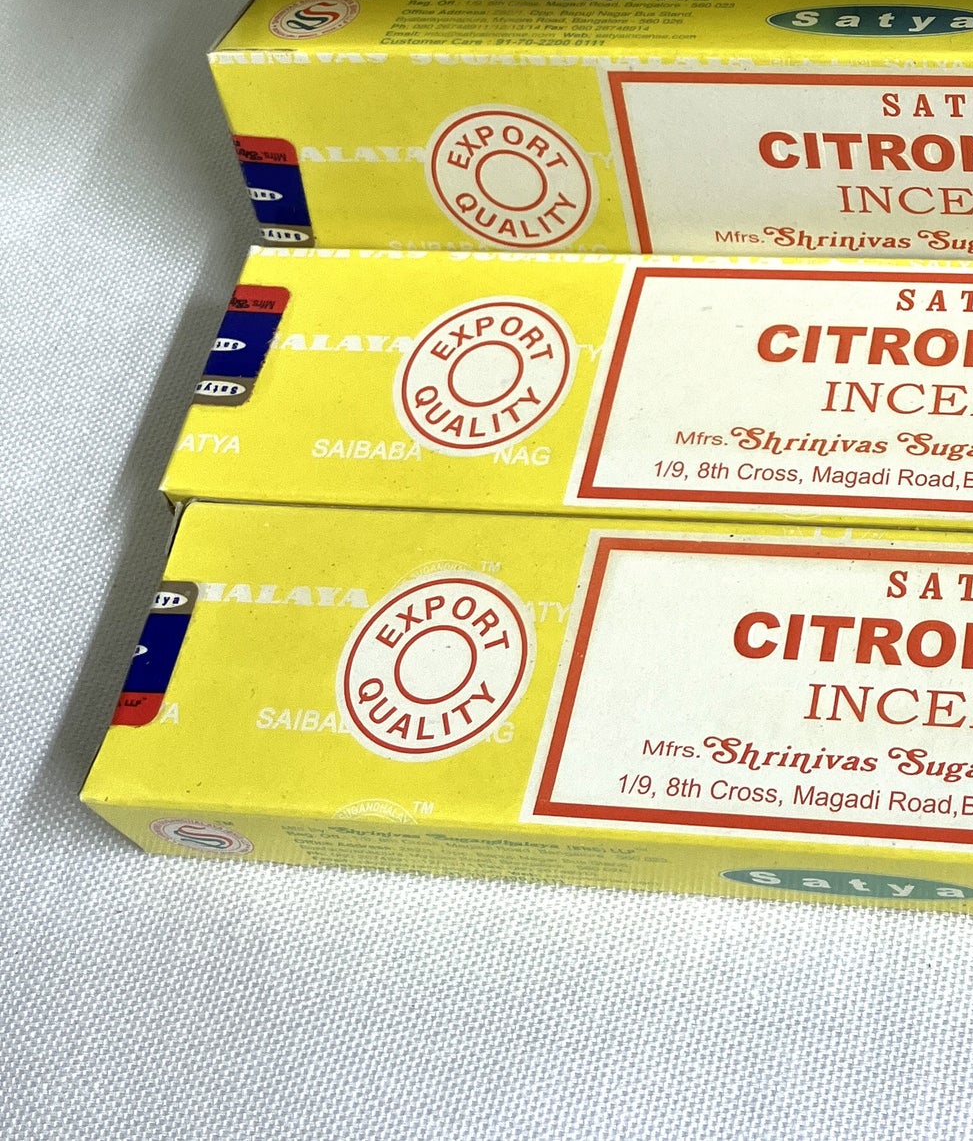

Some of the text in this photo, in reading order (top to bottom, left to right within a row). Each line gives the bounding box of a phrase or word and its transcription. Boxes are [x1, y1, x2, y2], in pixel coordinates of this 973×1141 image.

[448, 125, 568, 170] EXPORT
[455, 193, 577, 238] QUALITY
[715, 230, 764, 244] Mfrs.
[763, 227, 911, 250] Shrinivas
[430, 315, 554, 362] EXPORT
[415, 385, 540, 438] QUALITY
[312, 439, 550, 466] SAIBABA NAG
[675, 431, 728, 446] Mfrs.
[730, 427, 888, 456] Shrinivas
[655, 461, 689, 480] 1/9,
[697, 462, 729, 480] 8th
[737, 463, 803, 484] Cross,
[812, 466, 890, 489] Magadi
[376, 595, 509, 651] EXPORT
[358, 677, 495, 740] QUALITY
[643, 739, 700, 759] Mfrs.
[703, 736, 878, 773] Shrinivas
[618, 774, 656, 799] 1/9,
[666, 777, 701, 798] 8th
[710, 781, 783, 806] Cross,
[793, 785, 880, 813] Magadi
[750, 871, 965, 899] Satya
